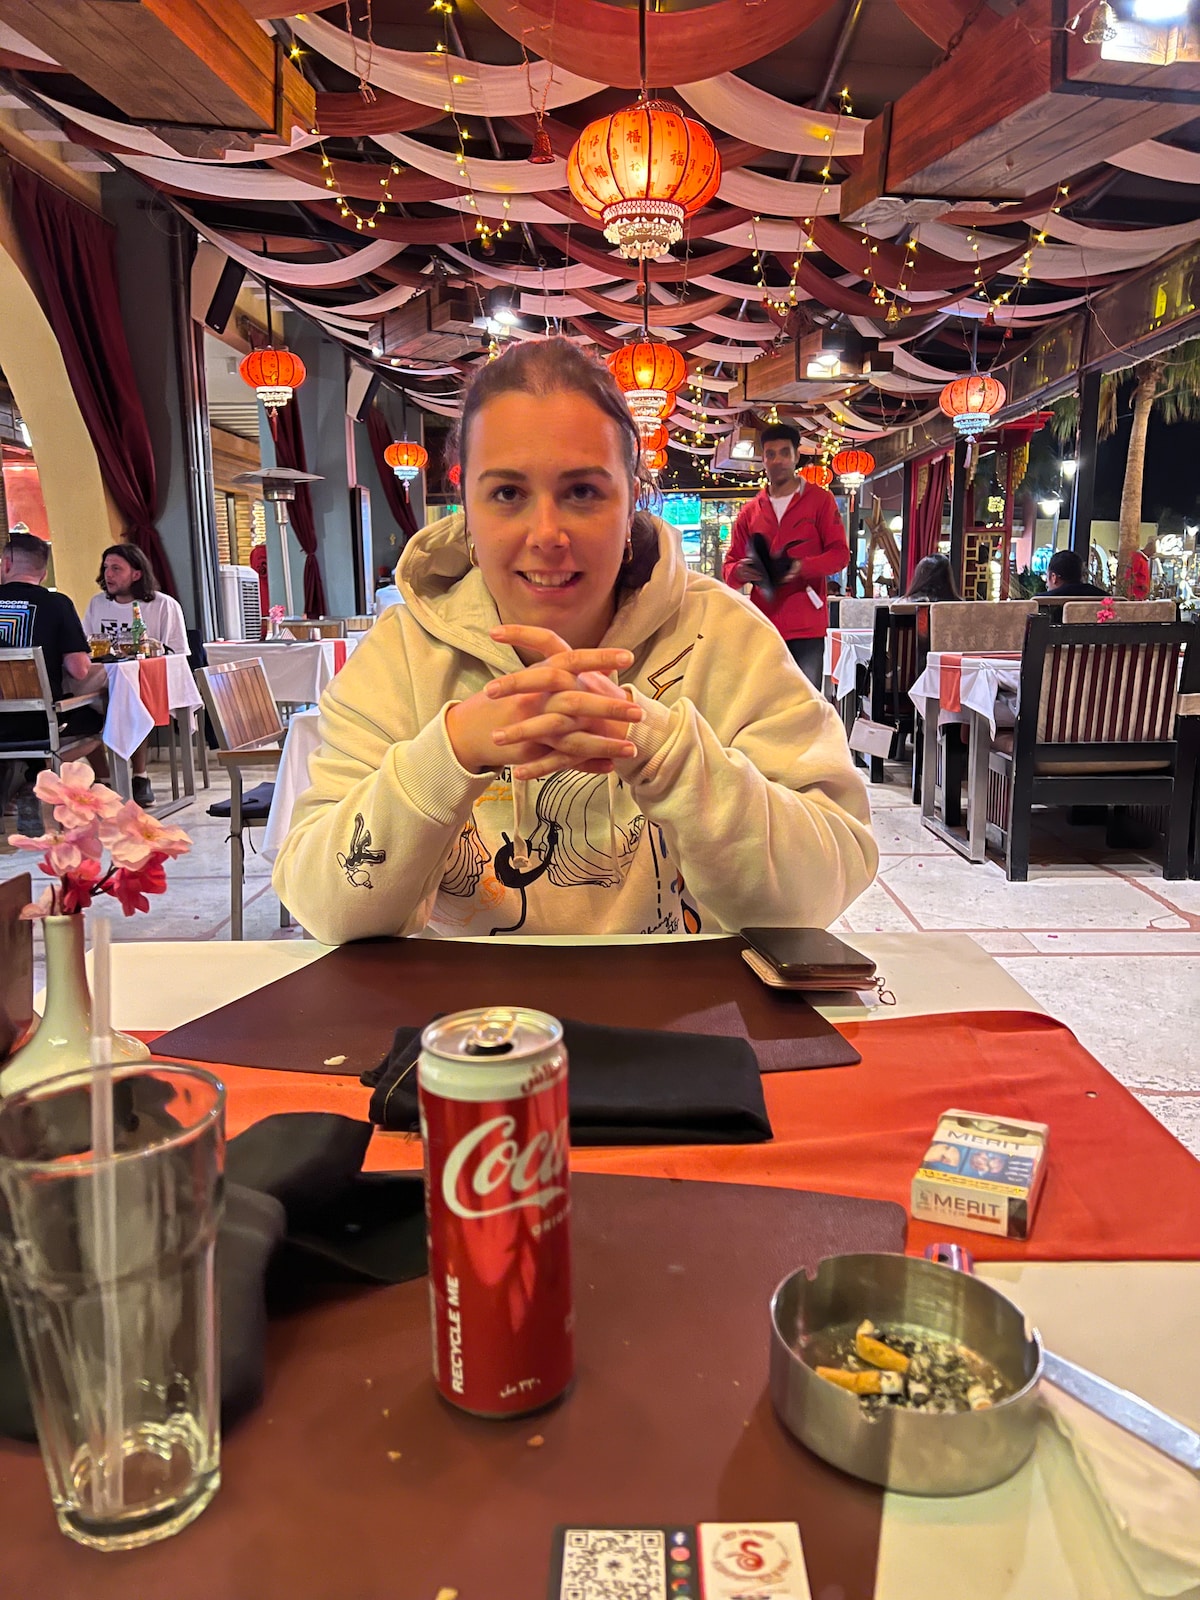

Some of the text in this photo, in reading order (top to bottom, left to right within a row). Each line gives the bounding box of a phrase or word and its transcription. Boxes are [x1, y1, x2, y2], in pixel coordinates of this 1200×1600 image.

[670, 149, 685, 167] 福
[947, 1130, 1021, 1151] MERIT
[934, 1193, 1000, 1217] MERIT
[446, 1274, 464, 1394] RECYCLE ME
